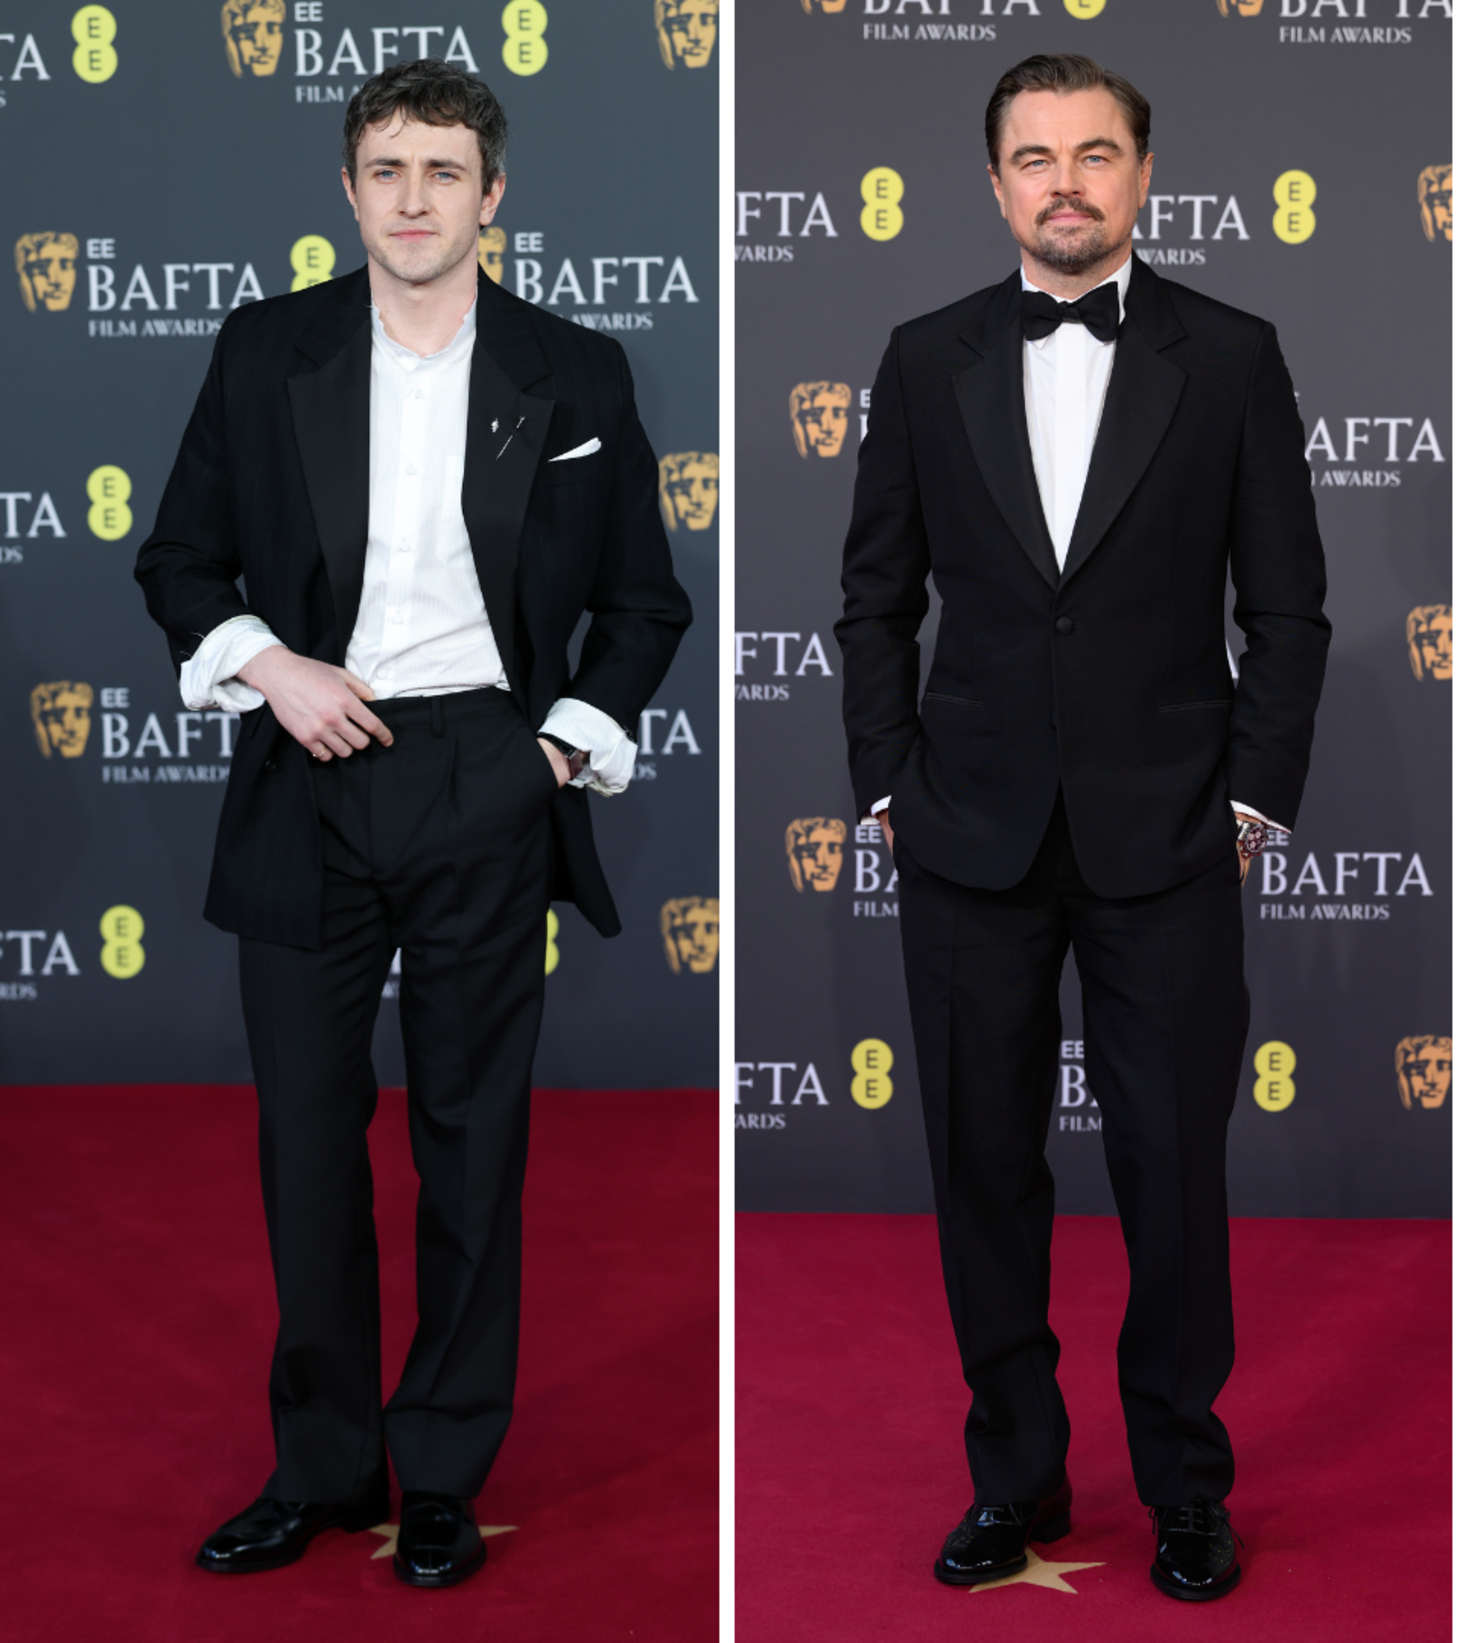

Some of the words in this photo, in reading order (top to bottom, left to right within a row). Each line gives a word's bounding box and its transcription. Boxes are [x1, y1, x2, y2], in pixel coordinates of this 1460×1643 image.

[294, 1, 323, 22] EE
[864, 24, 907, 40] FILM
[911, 24, 996, 41] AWARDS
[1280, 27, 1323, 43] FILM
[1327, 27, 1411, 43] AWARDS
[295, 27, 478, 76] BAFTA
[295, 85, 345, 103] FILM
[86, 238, 115, 259] EE
[514, 232, 544, 253] EE
[88, 263, 264, 311] BAFTA
[515, 257, 698, 304] BAFTA
[88, 319, 137, 337] FILM
[1320, 469, 1401, 487] AWARDS
[100, 687, 129, 708] EE
[102, 765, 150, 783] FILM
[856, 826, 880, 844] EE
[1262, 852, 1433, 895] BAFTA
[853, 900, 899, 918] FILM
[1260, 903, 1306, 920] FILM
[1310, 903, 1390, 920] AWARDS
